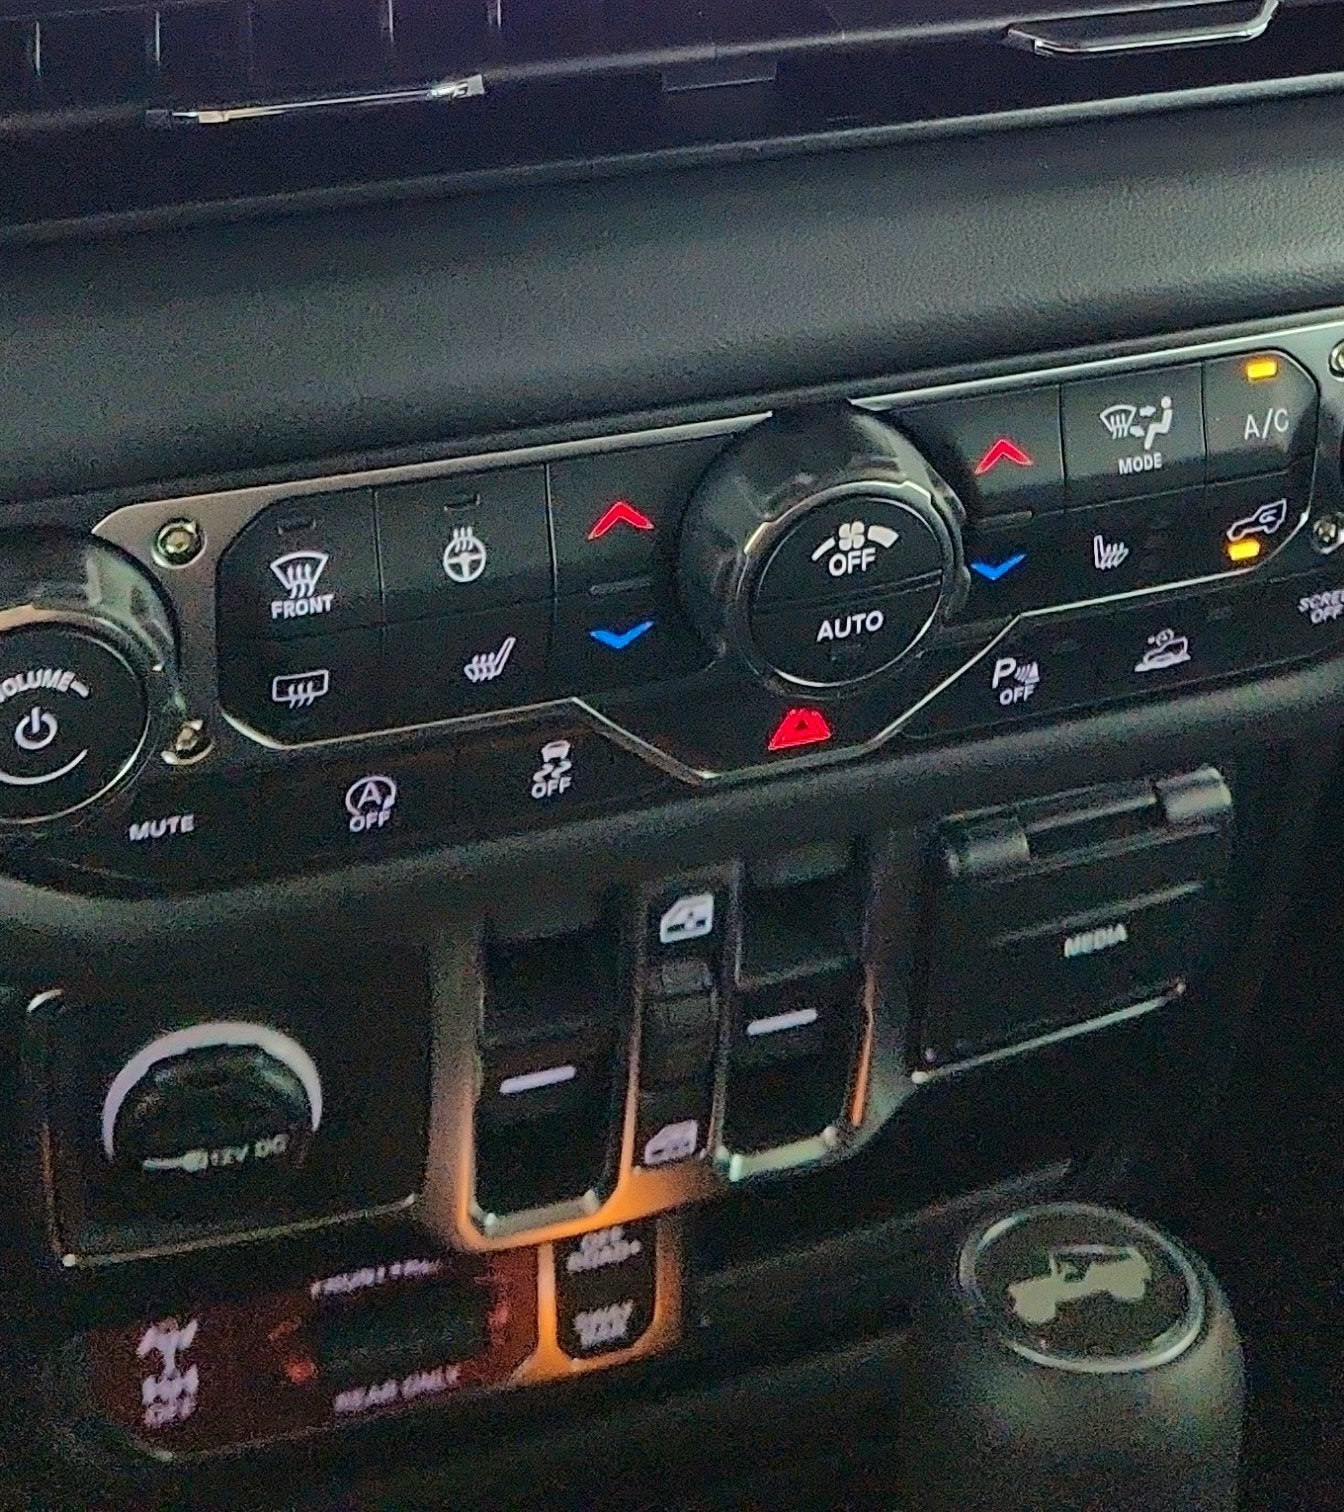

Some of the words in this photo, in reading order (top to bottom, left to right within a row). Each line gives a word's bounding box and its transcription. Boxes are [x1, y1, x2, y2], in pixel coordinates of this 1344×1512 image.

[1244, 407, 1289, 441] A/C
[1118, 451, 1162, 475] MODE
[828, 546, 876, 577] OFF
[271, 593, 335, 620] FRONT
[1310, 603, 1344, 624] OFF
[816, 609, 885, 642] AUTO
[999, 684, 1036, 706] OFF
[531, 776, 572, 799] OFF
[128, 814, 195, 842] MUTE
[349, 809, 391, 833] OFF
